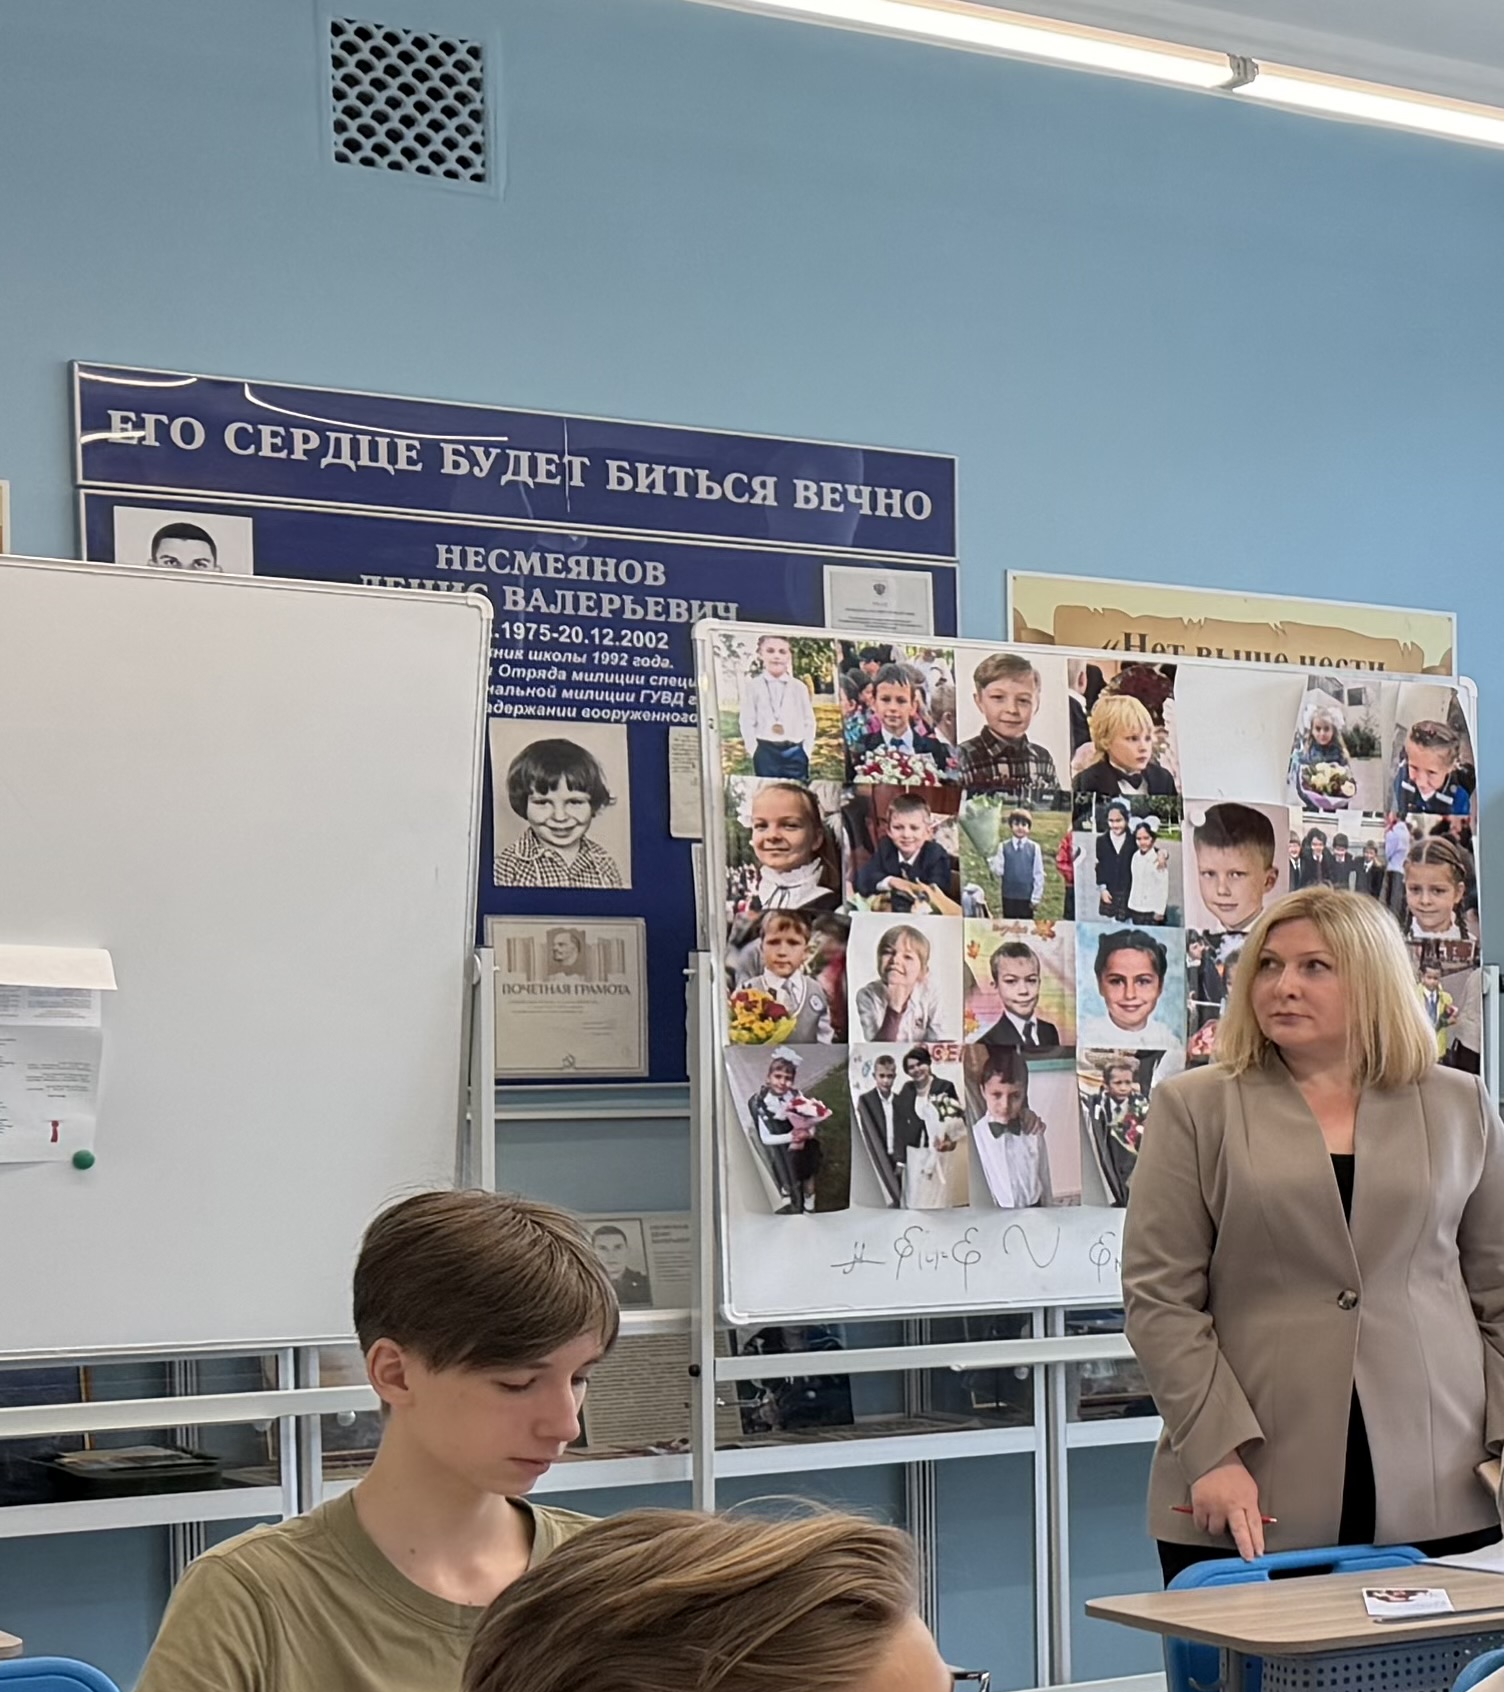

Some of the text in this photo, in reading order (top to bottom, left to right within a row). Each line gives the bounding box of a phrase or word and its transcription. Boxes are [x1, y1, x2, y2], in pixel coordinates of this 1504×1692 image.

[106, 409, 933, 521] ЕГО СЕРДЦЕ БУДЕТ БИТЬСЯ ВЕЧНО
[435, 543, 666, 587] НЕСМЕЯНОВ
[502, 584, 740, 624] ВАЛЕРЬЕВИЧ
[489, 647, 674, 669] ник школы 1992 года.
[498, 663, 567, 682] Отряда
[571, 671, 645, 687] милиции
[561, 688, 635, 704] милиции
[639, 689, 686, 708] ГУВД
[575, 983, 631, 995] ГРАМОТА
